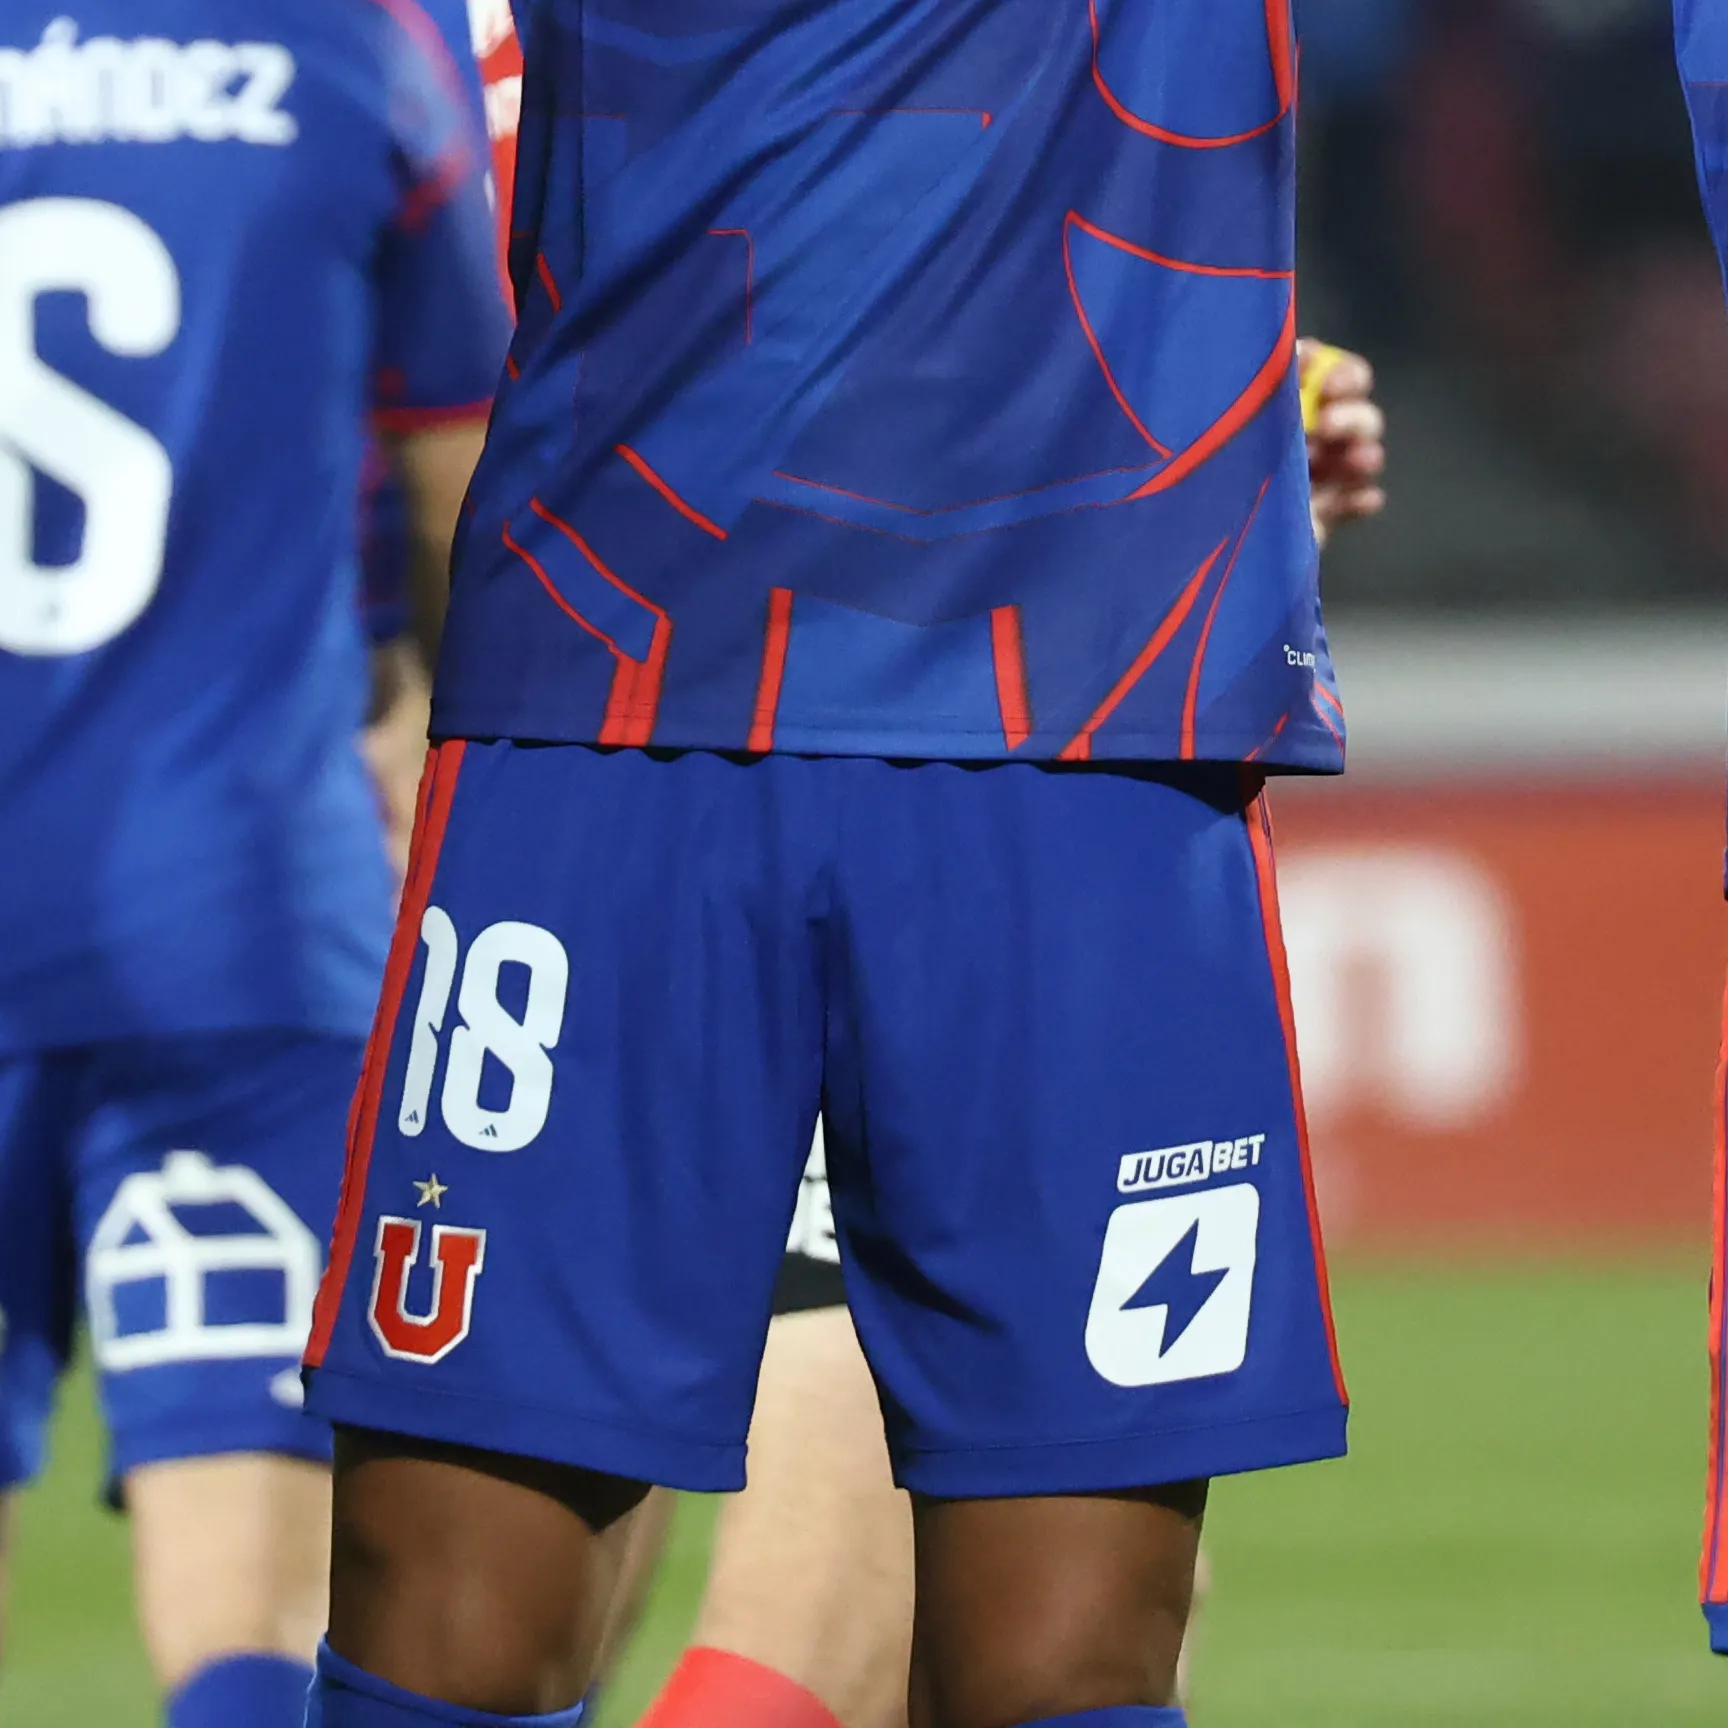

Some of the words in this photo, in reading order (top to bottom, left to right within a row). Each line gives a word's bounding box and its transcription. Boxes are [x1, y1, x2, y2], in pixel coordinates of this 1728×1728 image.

[396, 905, 571, 1153] 18
[1122, 1133, 1266, 1187] JUGABET
[365, 1215, 486, 1365] U
